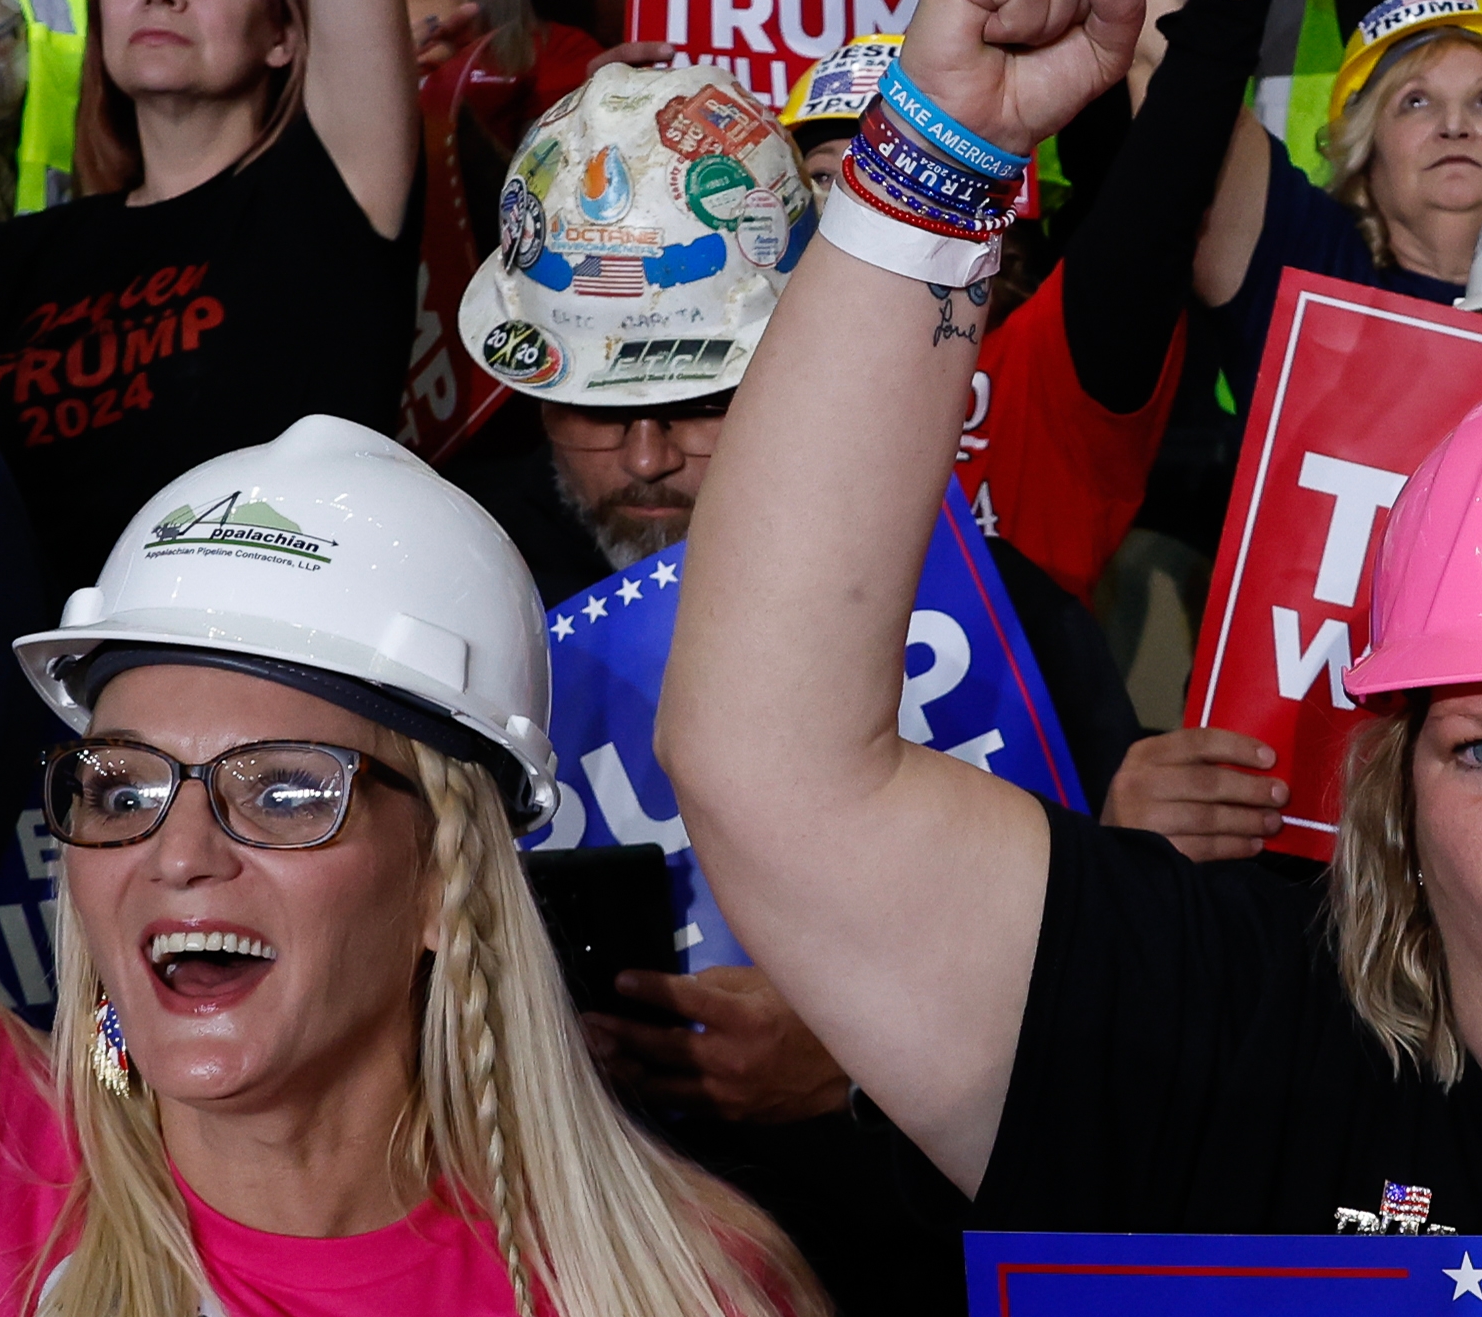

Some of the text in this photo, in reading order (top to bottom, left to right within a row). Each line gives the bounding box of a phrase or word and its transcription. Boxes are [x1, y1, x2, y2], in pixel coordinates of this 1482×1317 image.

[887, 80, 1000, 175] TAKE AMERICA
[878, 139, 974, 202] TRUMP
[919, 156, 950, 178] 2024
[564, 226, 660, 246] OCTANE
[18, 371, 156, 449] 2024
[144, 545, 322, 573] Appalachian Pipeline Contractors, LLP
